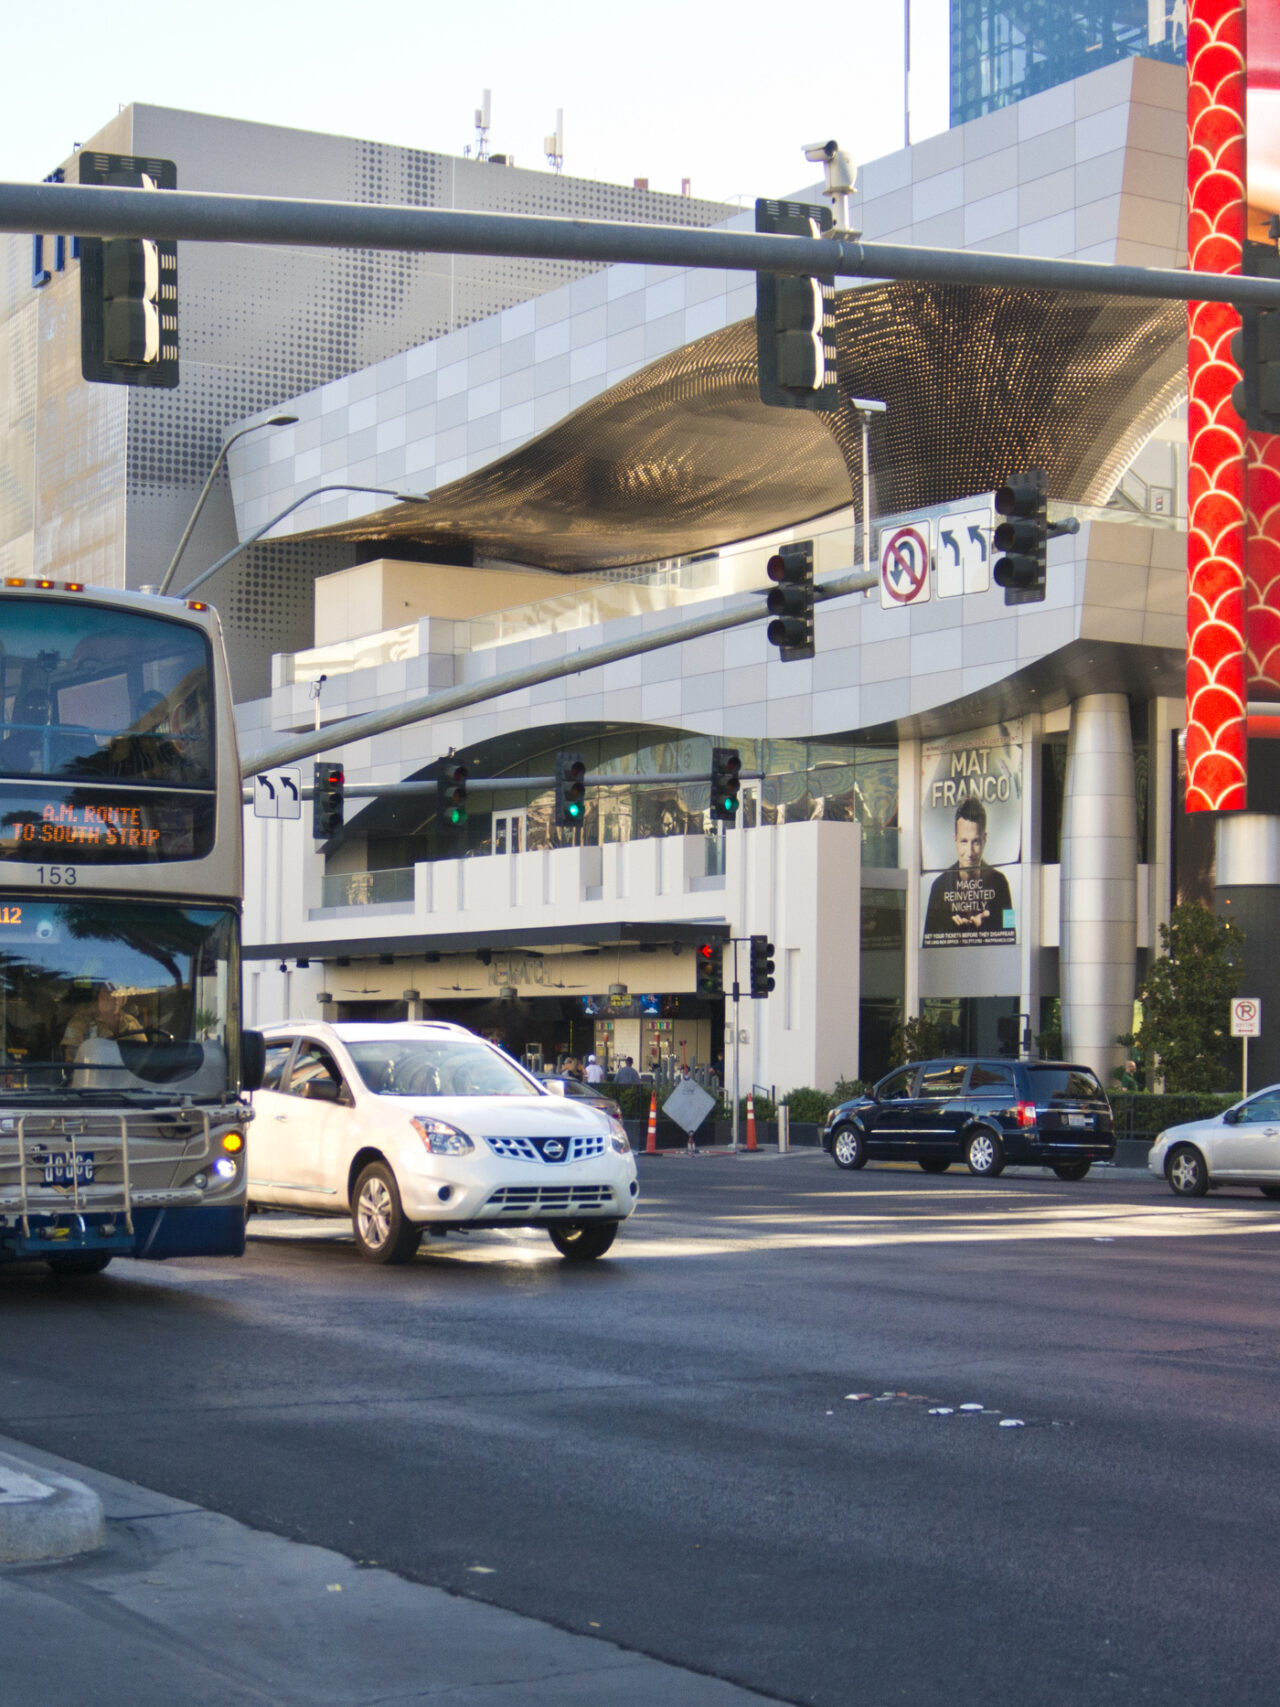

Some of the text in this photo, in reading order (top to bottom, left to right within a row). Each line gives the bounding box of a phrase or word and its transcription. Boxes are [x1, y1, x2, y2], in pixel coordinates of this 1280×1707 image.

[951, 749, 991, 777] MAT
[932, 775, 1010, 807] FRANCO
[42, 804, 141, 826] A.M. ROUTE
[12, 823, 160, 847] TO SOUTH STRIP
[37, 866, 77, 885] 153
[956, 879, 983, 890] MAGIC
[944, 889, 995, 902] REINVENTED
[951, 901, 987, 912] NIGHTLY
